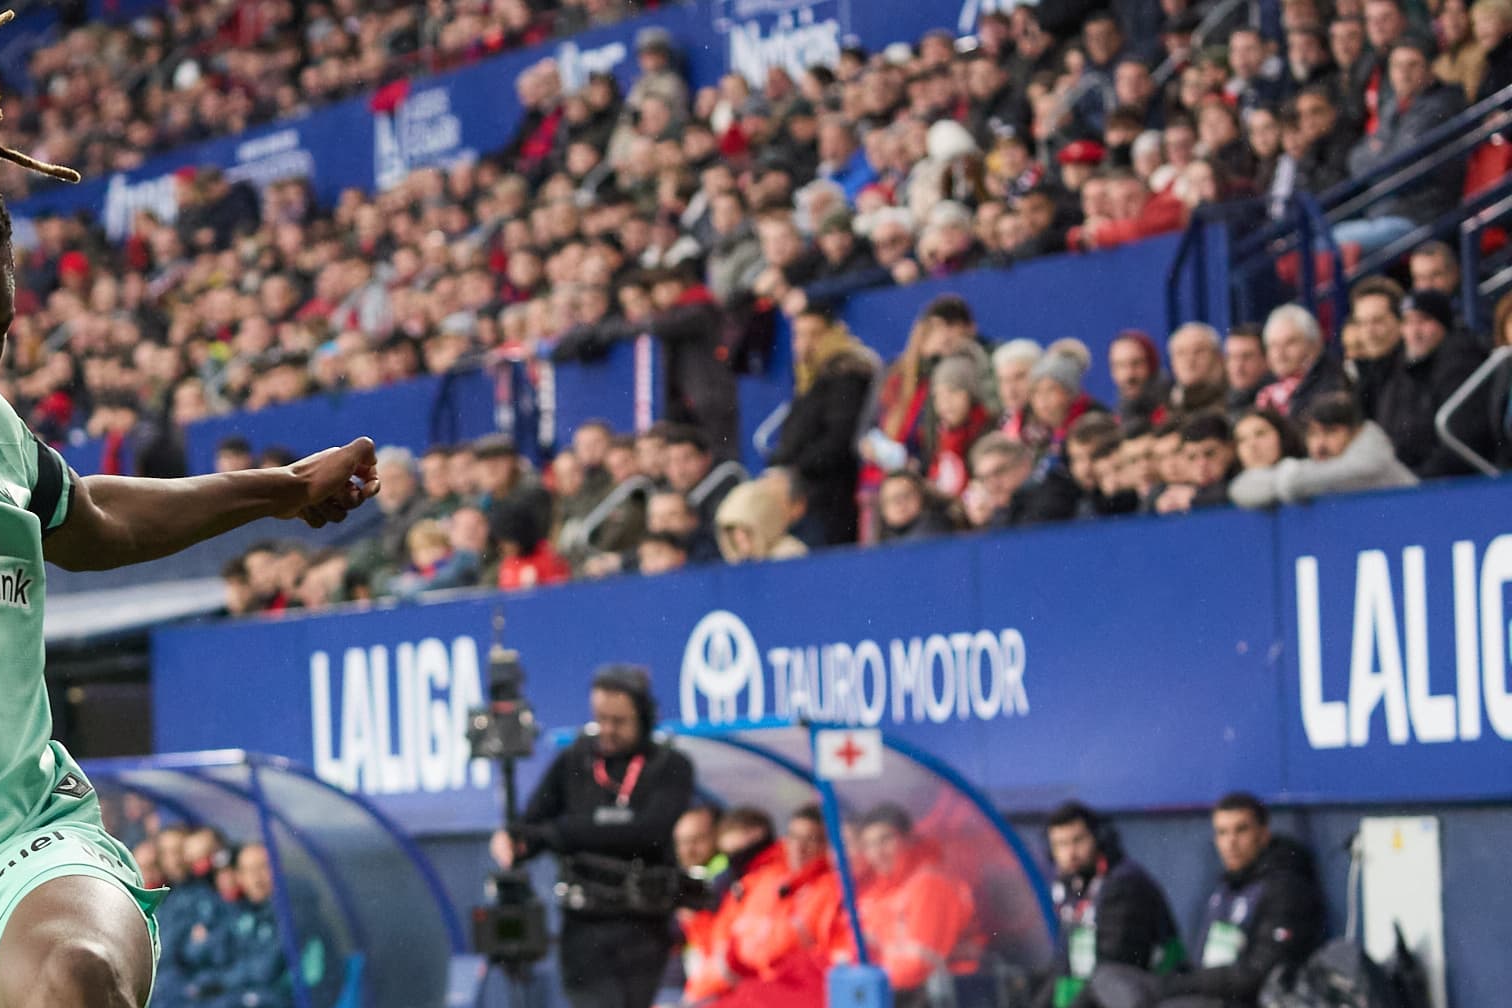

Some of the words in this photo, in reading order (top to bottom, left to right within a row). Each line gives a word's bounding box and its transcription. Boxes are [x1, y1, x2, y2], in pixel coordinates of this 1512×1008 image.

[310, 635, 491, 795] LALIGA
[767, 640, 887, 727] TAURO
[890, 628, 1031, 725] MOTOR
